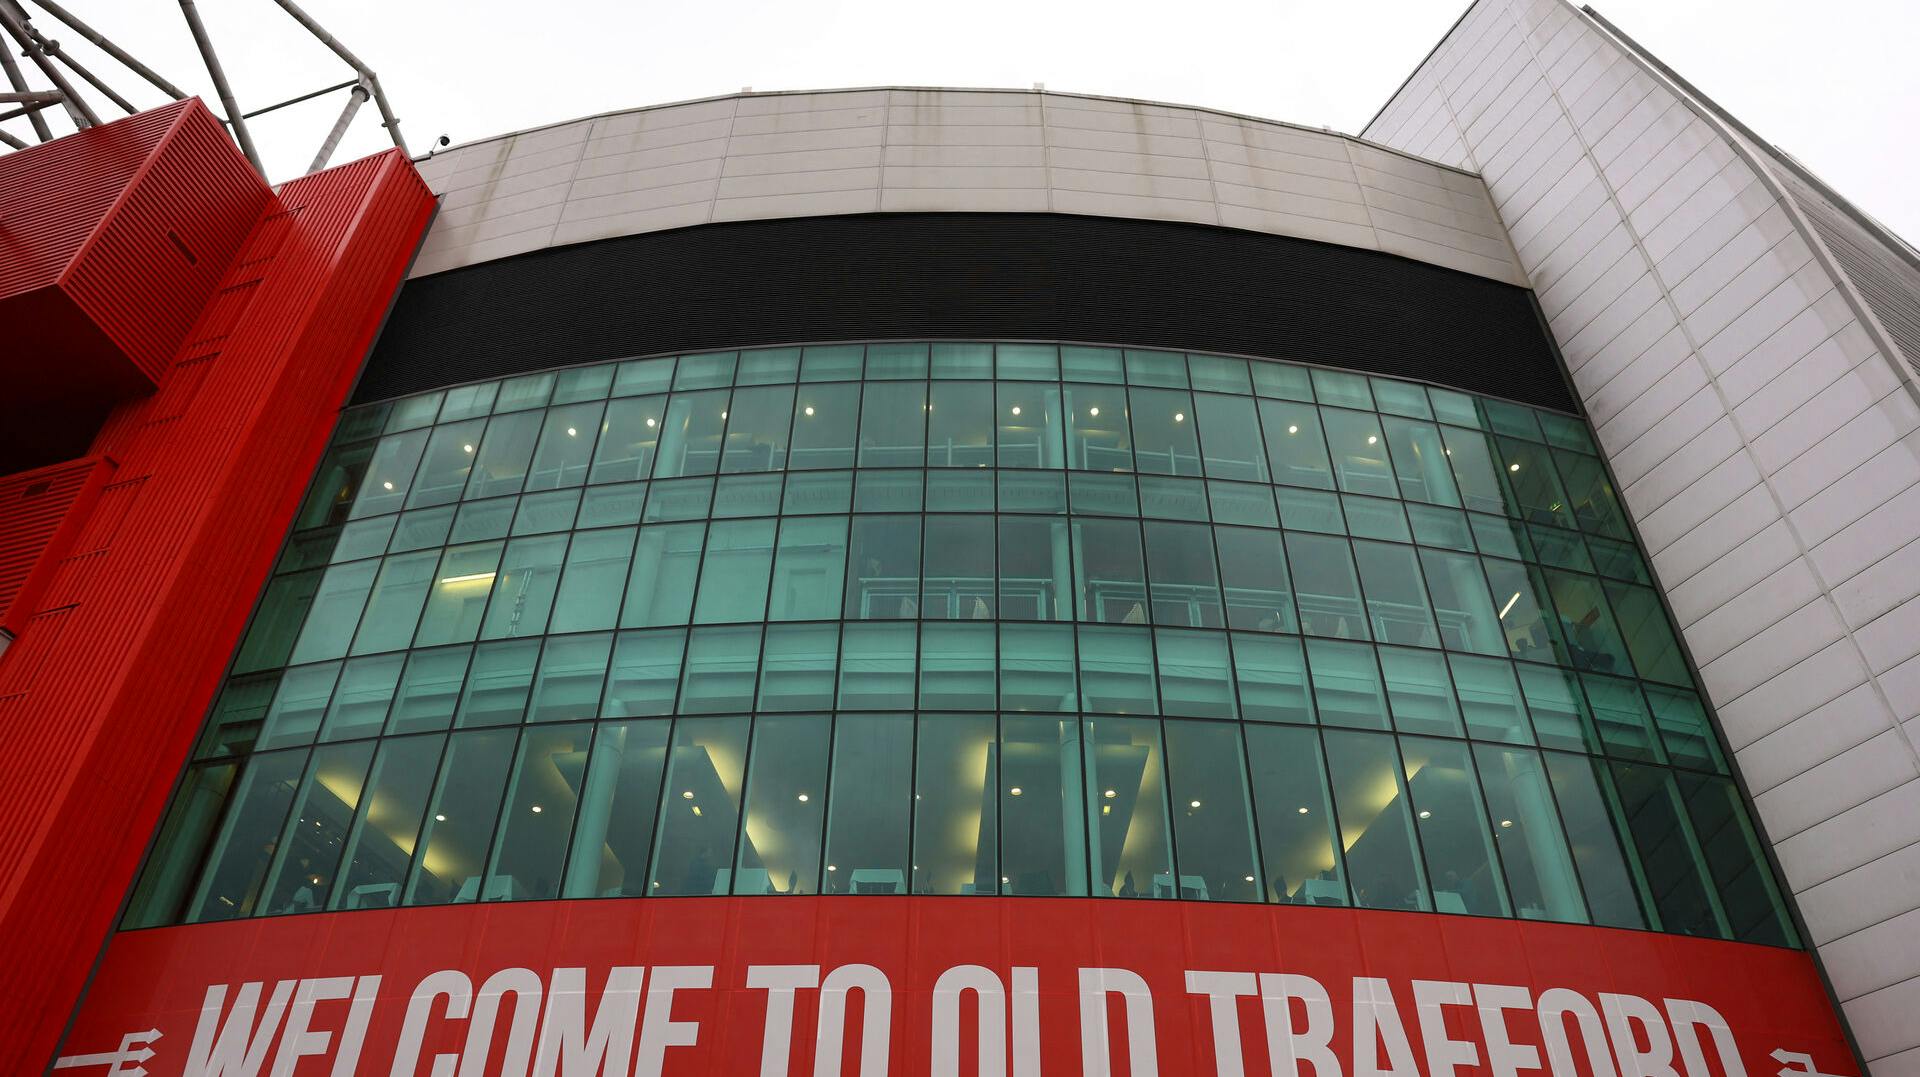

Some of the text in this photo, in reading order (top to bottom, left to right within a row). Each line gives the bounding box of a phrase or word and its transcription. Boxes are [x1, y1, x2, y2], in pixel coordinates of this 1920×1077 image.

[183, 964, 1747, 1077] WELCOME TO OLD TRAFFORD
